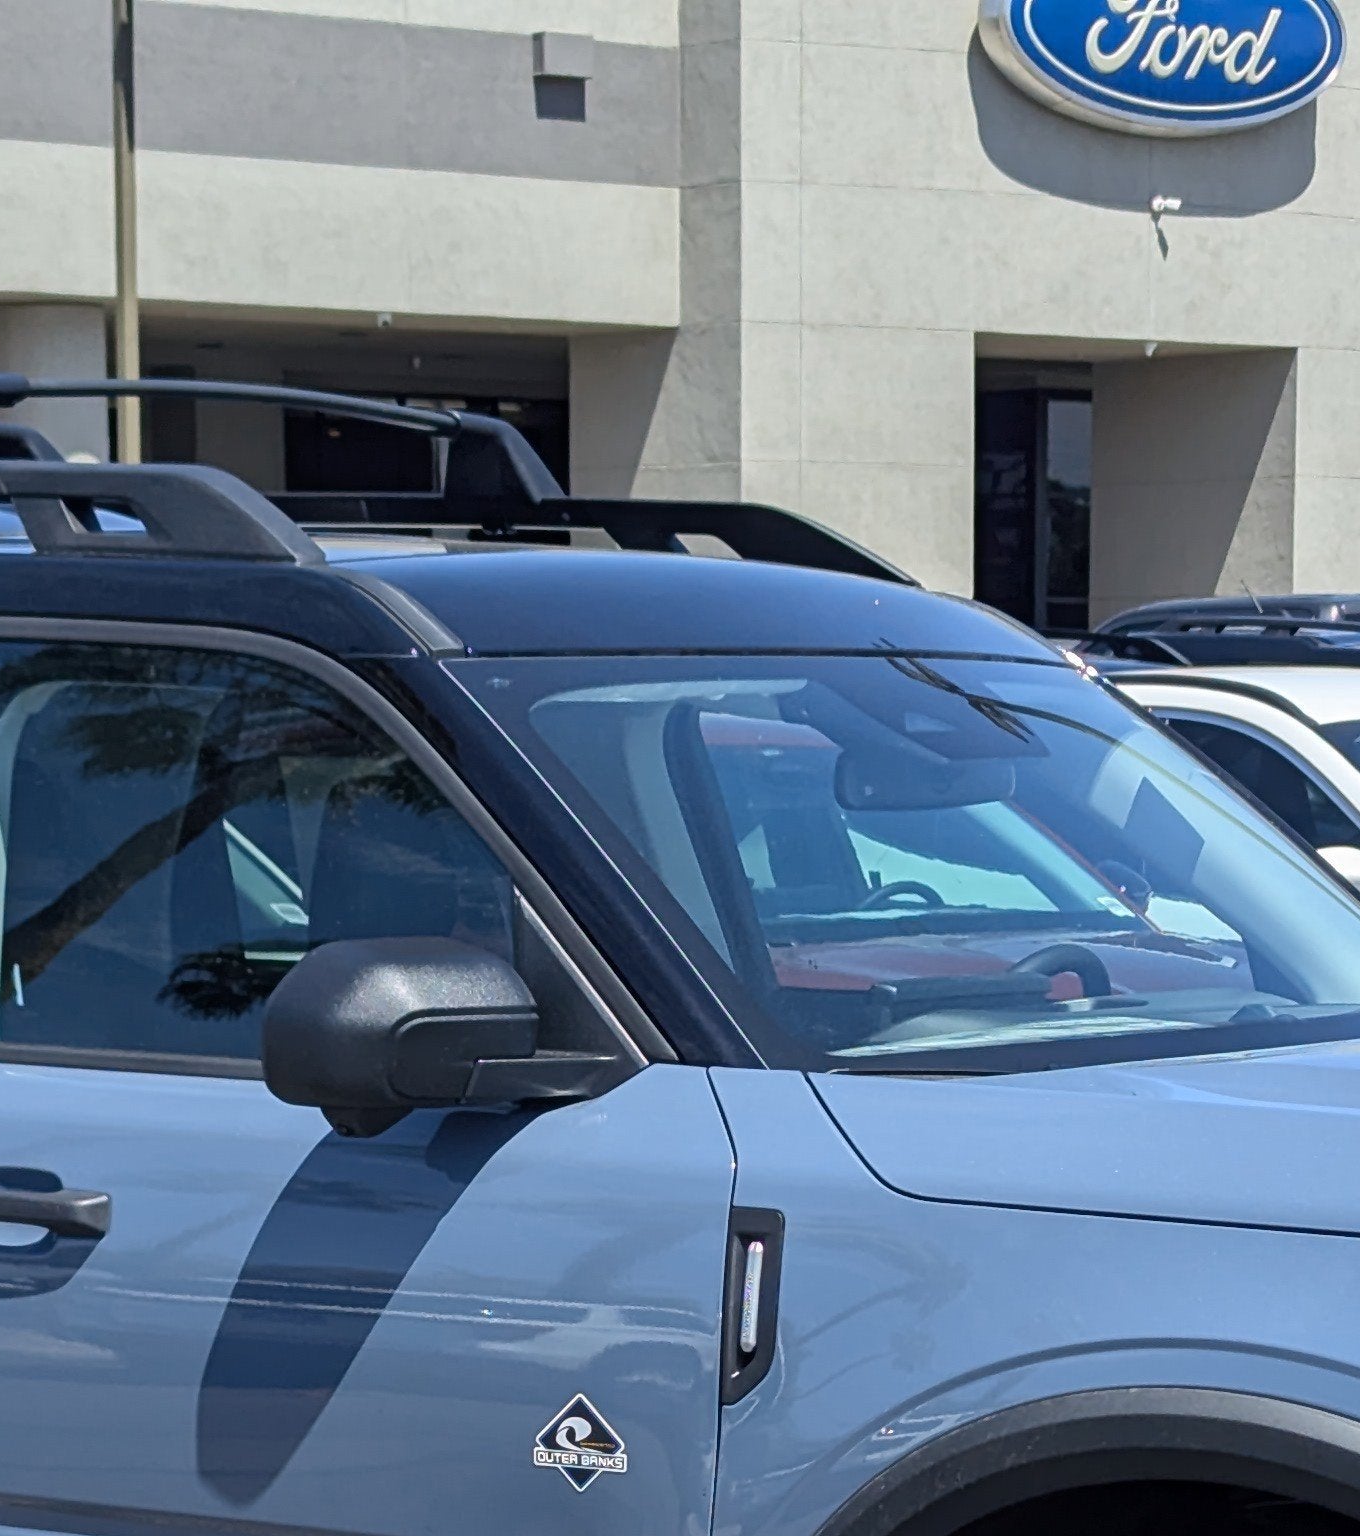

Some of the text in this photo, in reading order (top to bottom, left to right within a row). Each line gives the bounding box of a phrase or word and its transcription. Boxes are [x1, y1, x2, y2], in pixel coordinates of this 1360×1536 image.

[1086, 0, 1282, 84] Ford
[537, 1451, 623, 1469] OUTER BANKS
